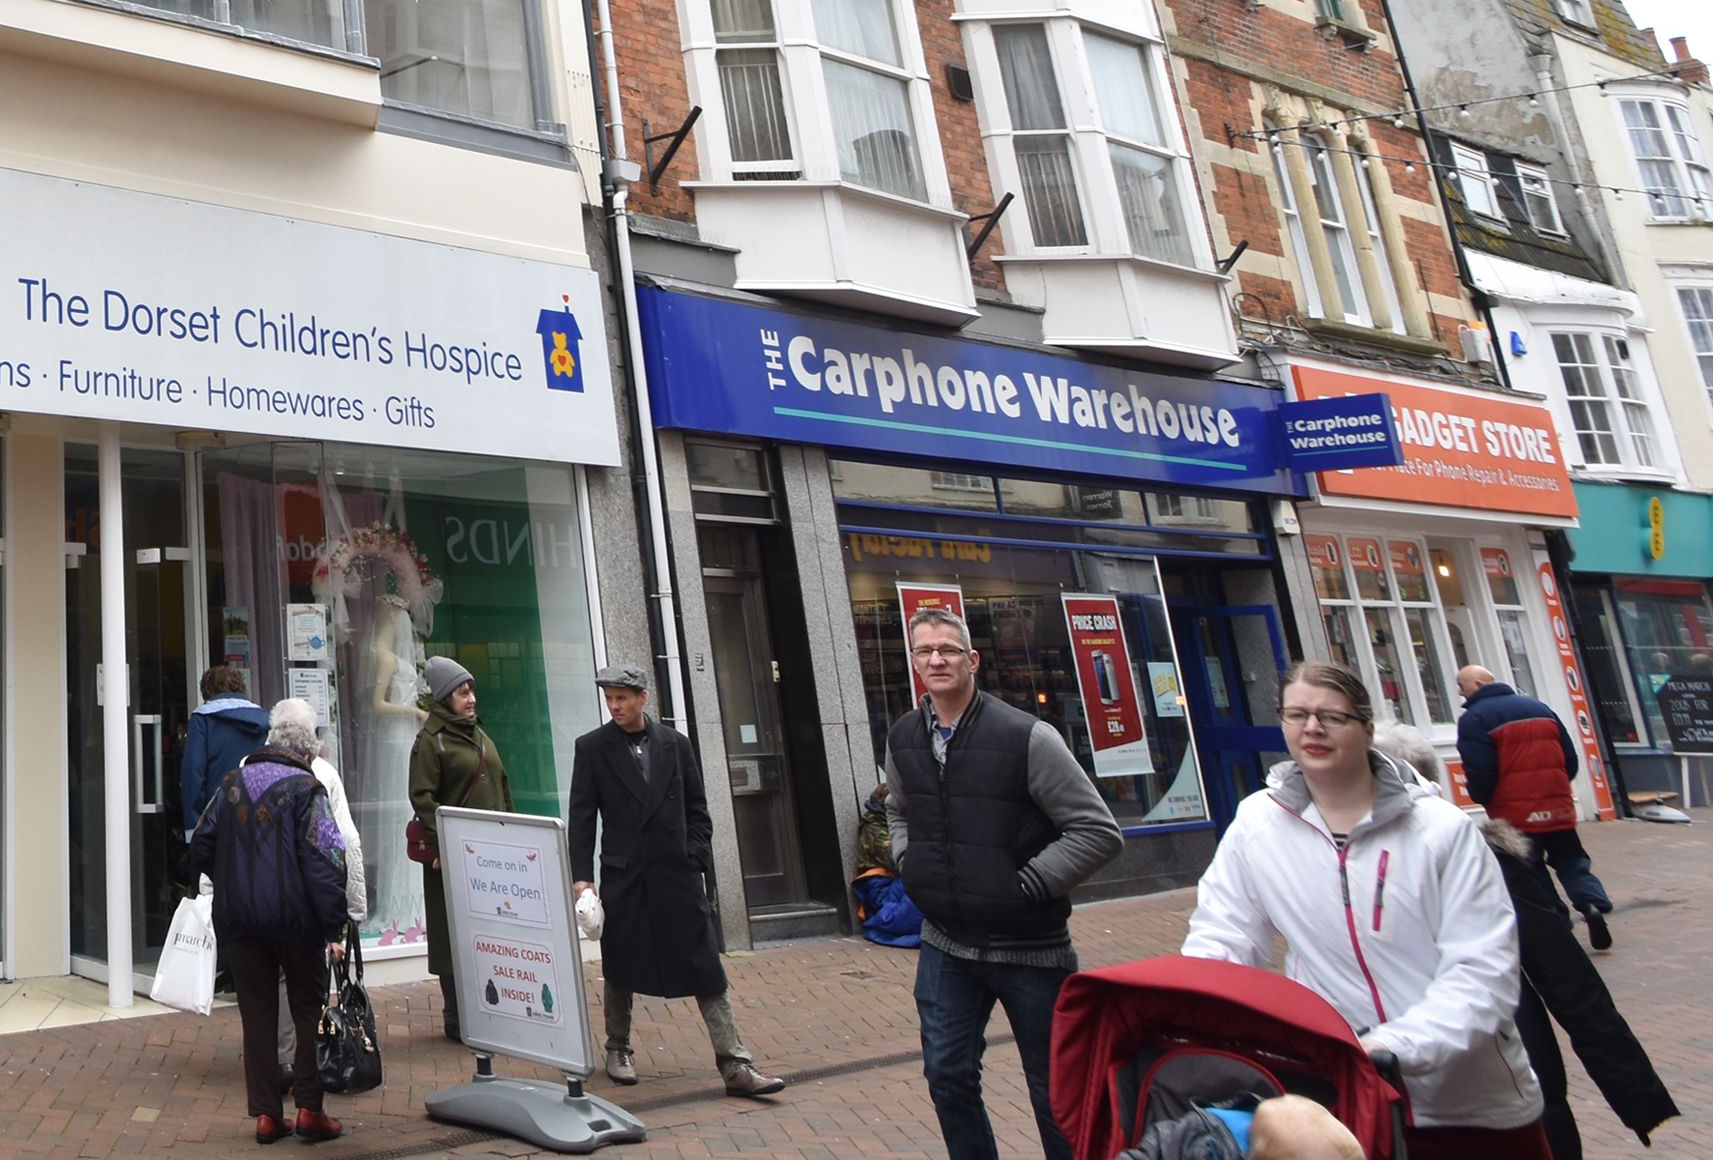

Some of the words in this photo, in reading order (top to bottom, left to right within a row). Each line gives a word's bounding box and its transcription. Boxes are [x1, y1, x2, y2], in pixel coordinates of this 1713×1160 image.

[18, 276, 90, 327] The
[103, 289, 221, 345] Dorset
[233, 308, 394, 366] Children's
[404, 339, 523, 387] Hospice
[58, 360, 183, 406] Furniture
[207, 376, 365, 424] Homewares
[385, 395, 436, 430] Gifts
[761, 328, 787, 391] THE
[788, 334, 1021, 418] Carphone
[1022, 371, 1241, 448] Warehouse
[1294, 414, 1382, 432] Carphone
[1290, 431, 1387, 449] Warehouse
[1481, 420, 1557, 465] STORE
[1417, 458, 1433, 477] For
[1435, 460, 1470, 481] Phone
[1469, 465, 1498, 487] Repair
[1508, 469, 1560, 492] Accessories
[1072, 615, 1094, 630] PRICE
[1093, 615, 1118, 630] CRASH
[476, 855, 502, 870] Come
[504, 861, 516, 871] on
[518, 861, 528, 872] in
[470, 878, 487, 892] We
[490, 880, 508, 895] Are
[511, 883, 541, 900] Open
[475, 941, 519, 959] AMAZING
[520, 949, 551, 964] COATS
[493, 965, 515, 979] SALE
[516, 969, 538, 983] RAIL
[501, 987, 535, 1004] INSIDE!
